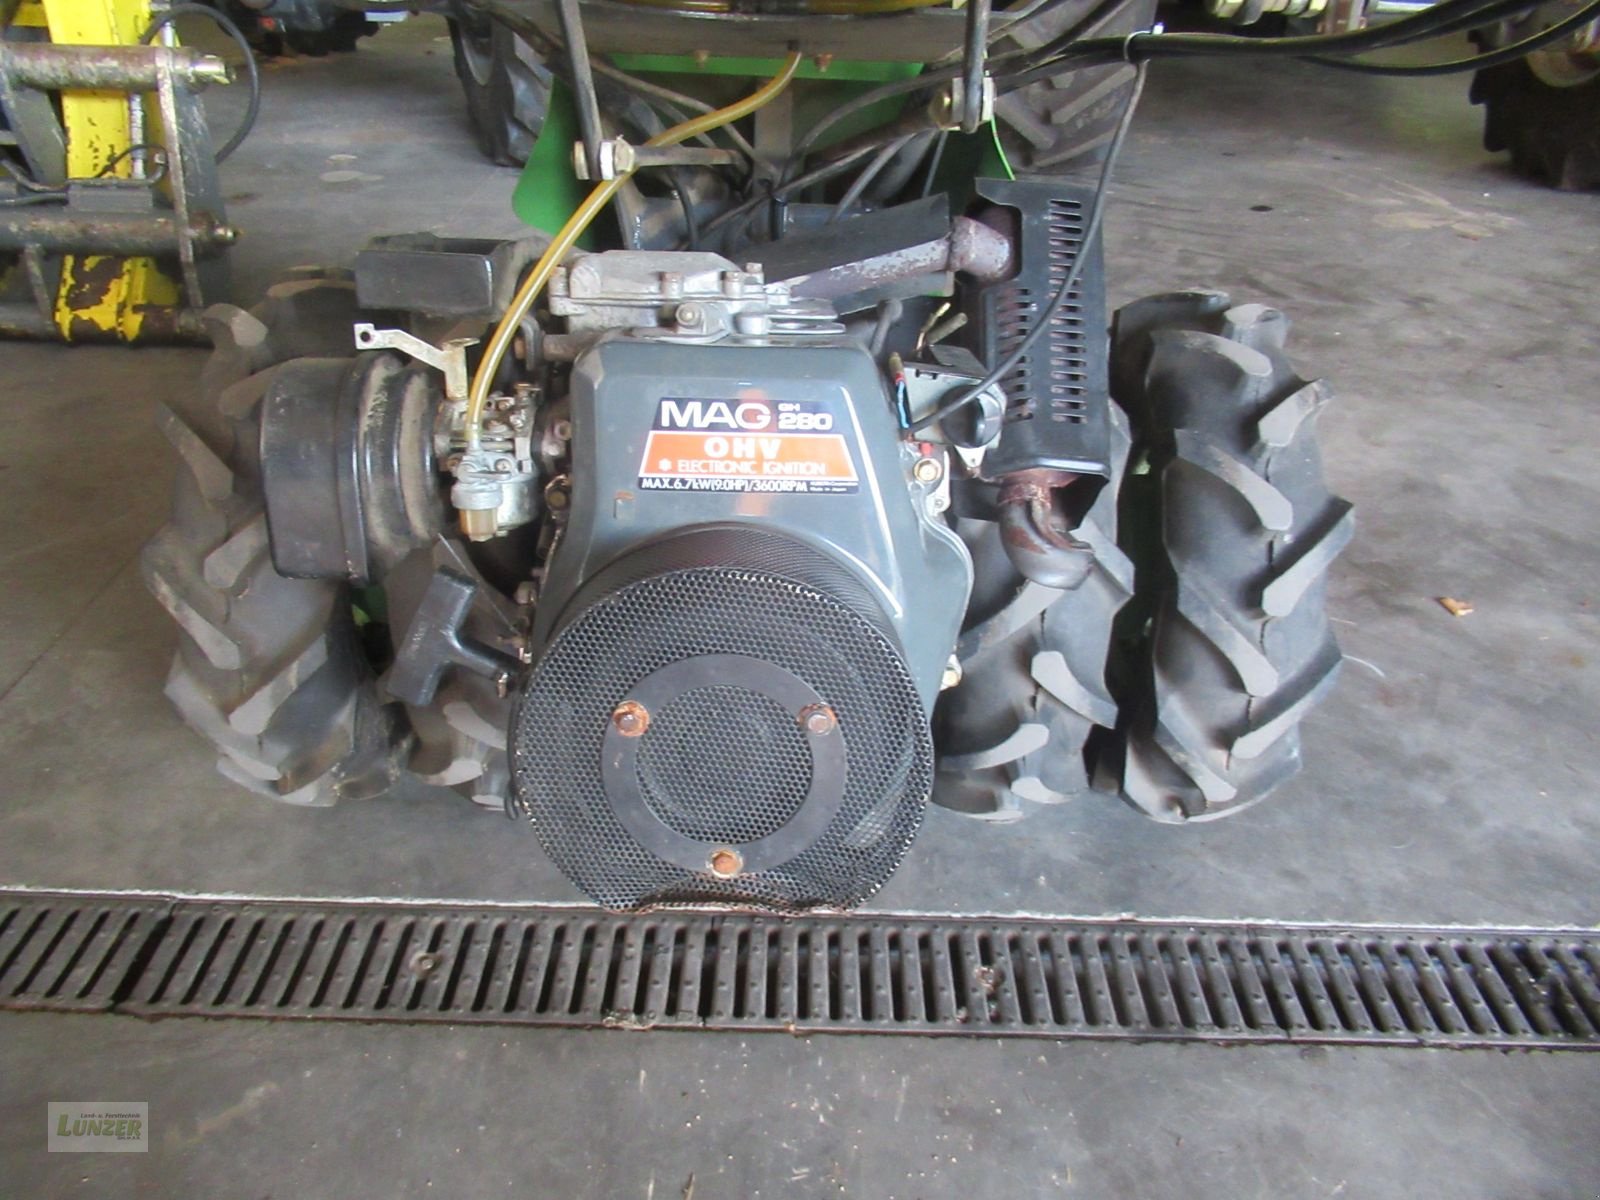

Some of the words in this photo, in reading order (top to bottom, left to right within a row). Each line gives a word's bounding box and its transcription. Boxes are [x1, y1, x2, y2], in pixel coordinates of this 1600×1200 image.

[661, 400, 771, 430] MAG
[778, 412, 834, 430] 280
[703, 436, 782, 460] OHV
[677, 458, 758, 474] ELECTRONIC
[763, 460, 827, 475] IGNITION
